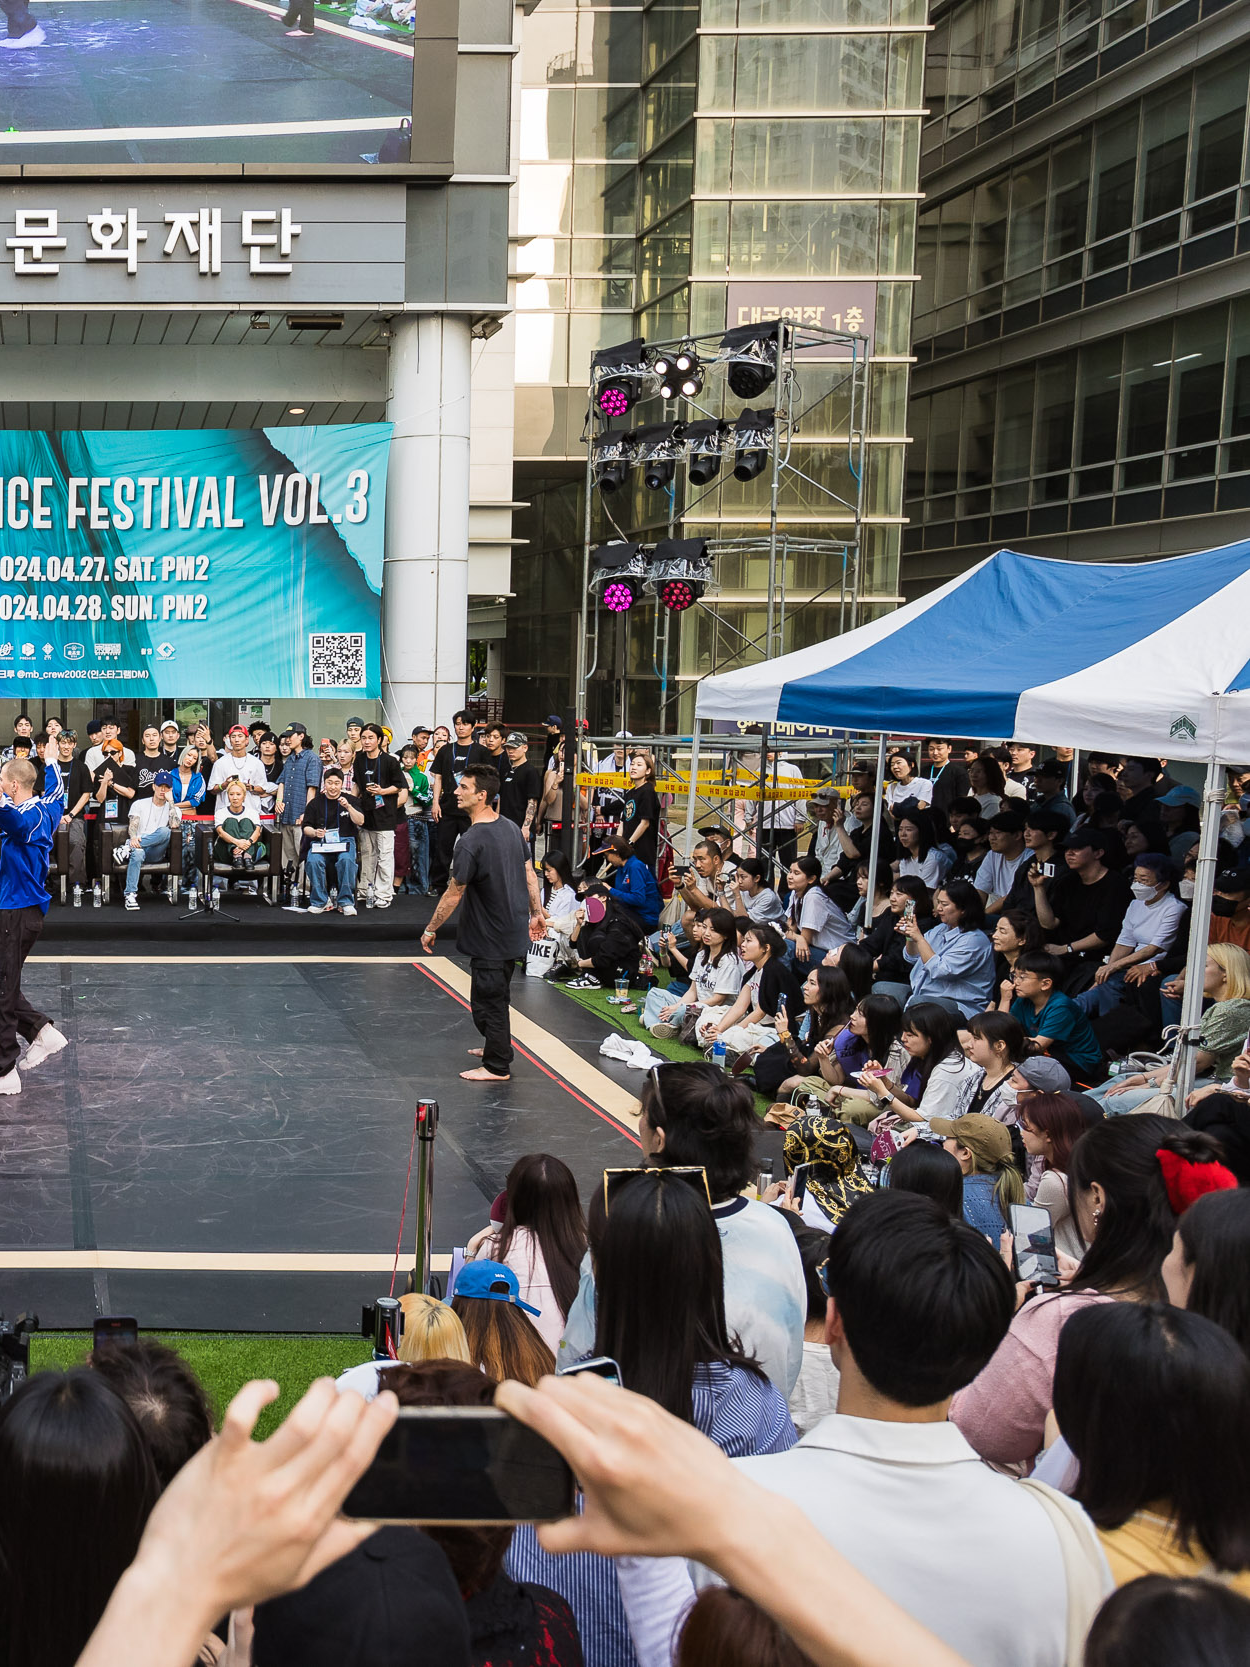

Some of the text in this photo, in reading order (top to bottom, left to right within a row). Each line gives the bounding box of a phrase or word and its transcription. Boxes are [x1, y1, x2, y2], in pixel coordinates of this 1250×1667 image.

[832, 306, 864, 332] 1층
[68, 475, 244, 530] FESTIVAL
[258, 469, 369, 527] VOL.3
[114, 555, 156, 582] SAT.
[162, 555, 208, 582] PM2
[110, 594, 158, 620] SUN.
[162, 594, 208, 620] PM2
[710, 787, 746, 798] 위험 출입금지
